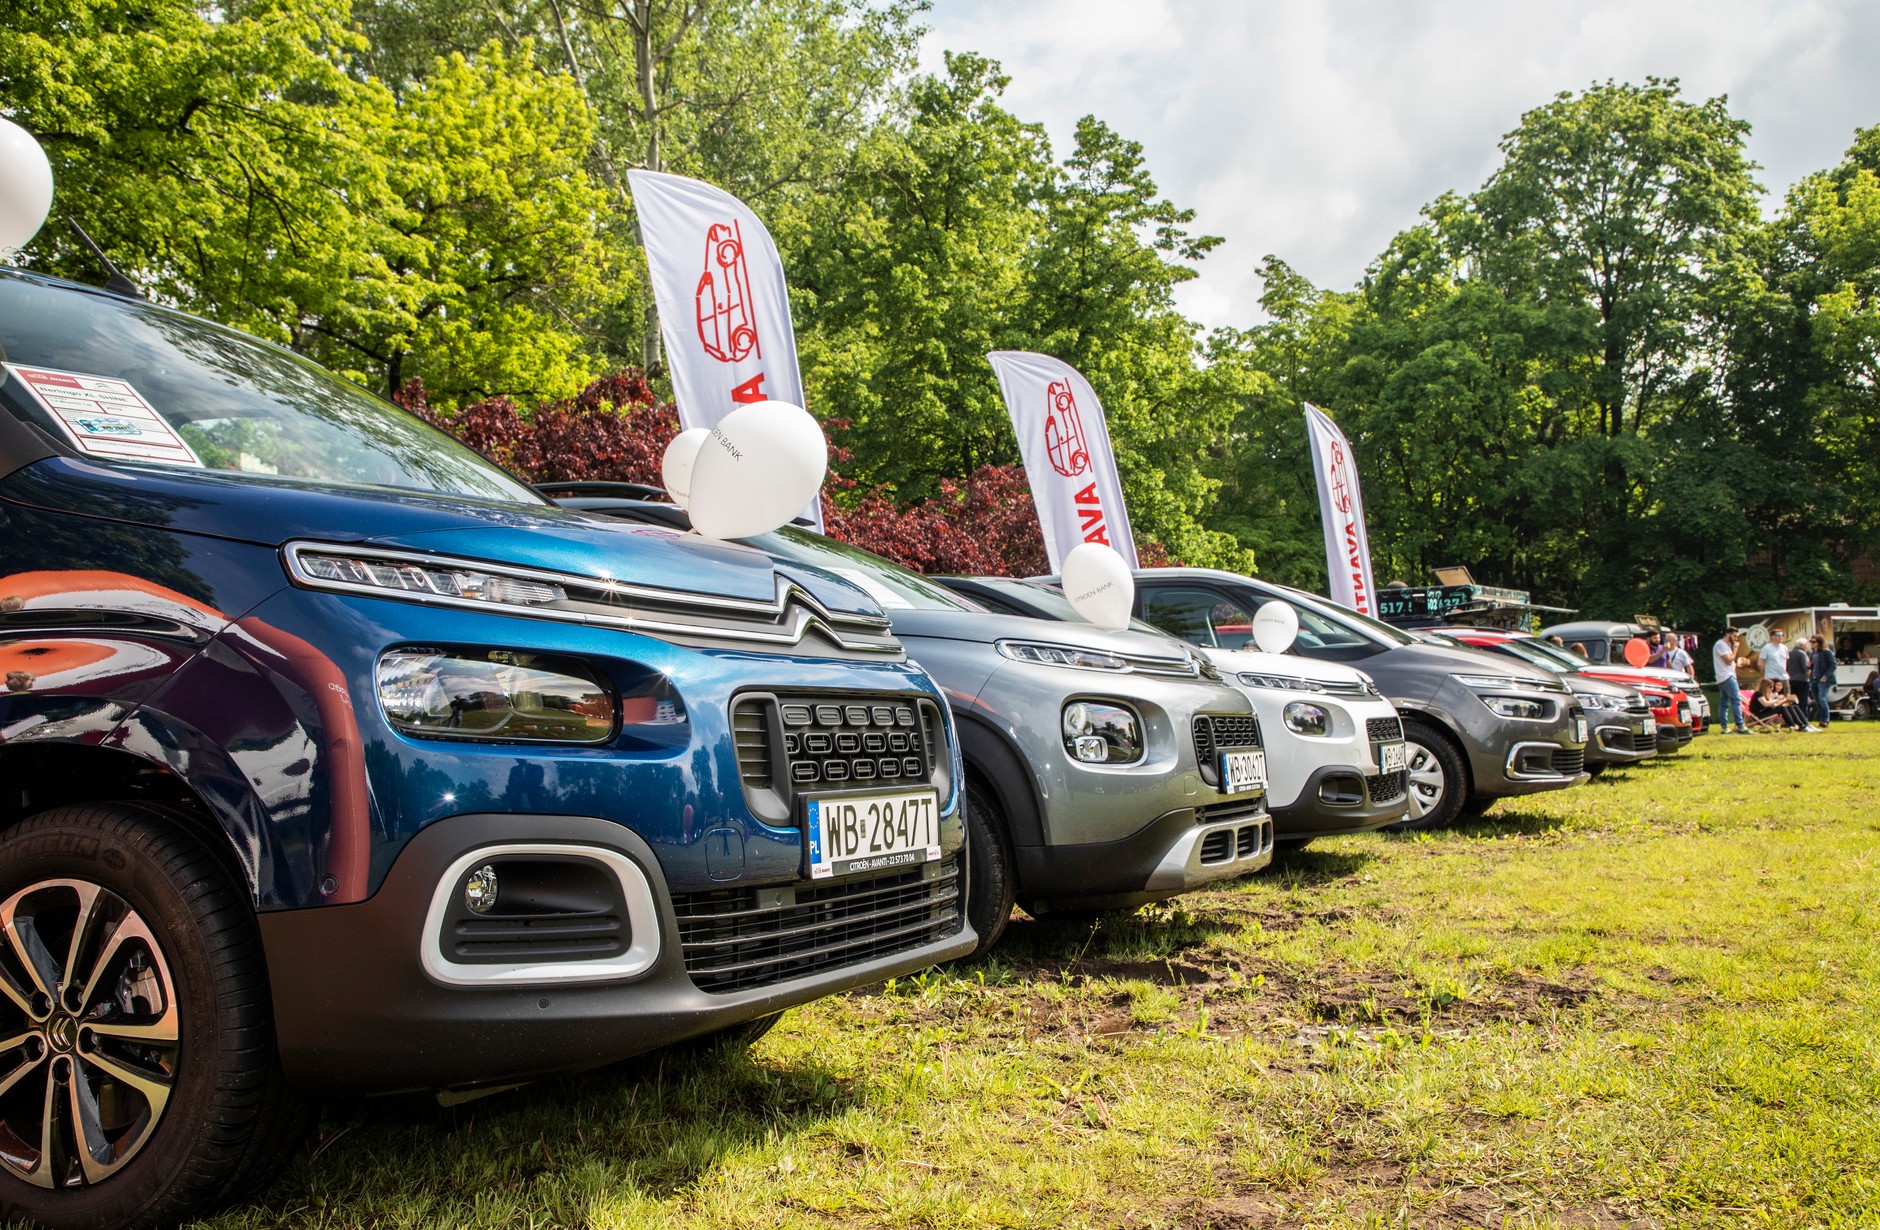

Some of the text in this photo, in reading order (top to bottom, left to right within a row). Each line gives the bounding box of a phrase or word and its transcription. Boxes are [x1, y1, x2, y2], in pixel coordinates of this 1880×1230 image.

[49, 376, 76, 384] AVANTI
[39, 386, 82, 397] Berlingo
[98, 394, 128, 403] SHINE
[720, 437, 743, 462] BANK
[1096, 581, 1113, 594] BANK
[1380, 601, 1404, 614] 517
[1228, 754, 1264, 784] WB 3062T
[809, 798, 932, 858] PL WB 2847T
